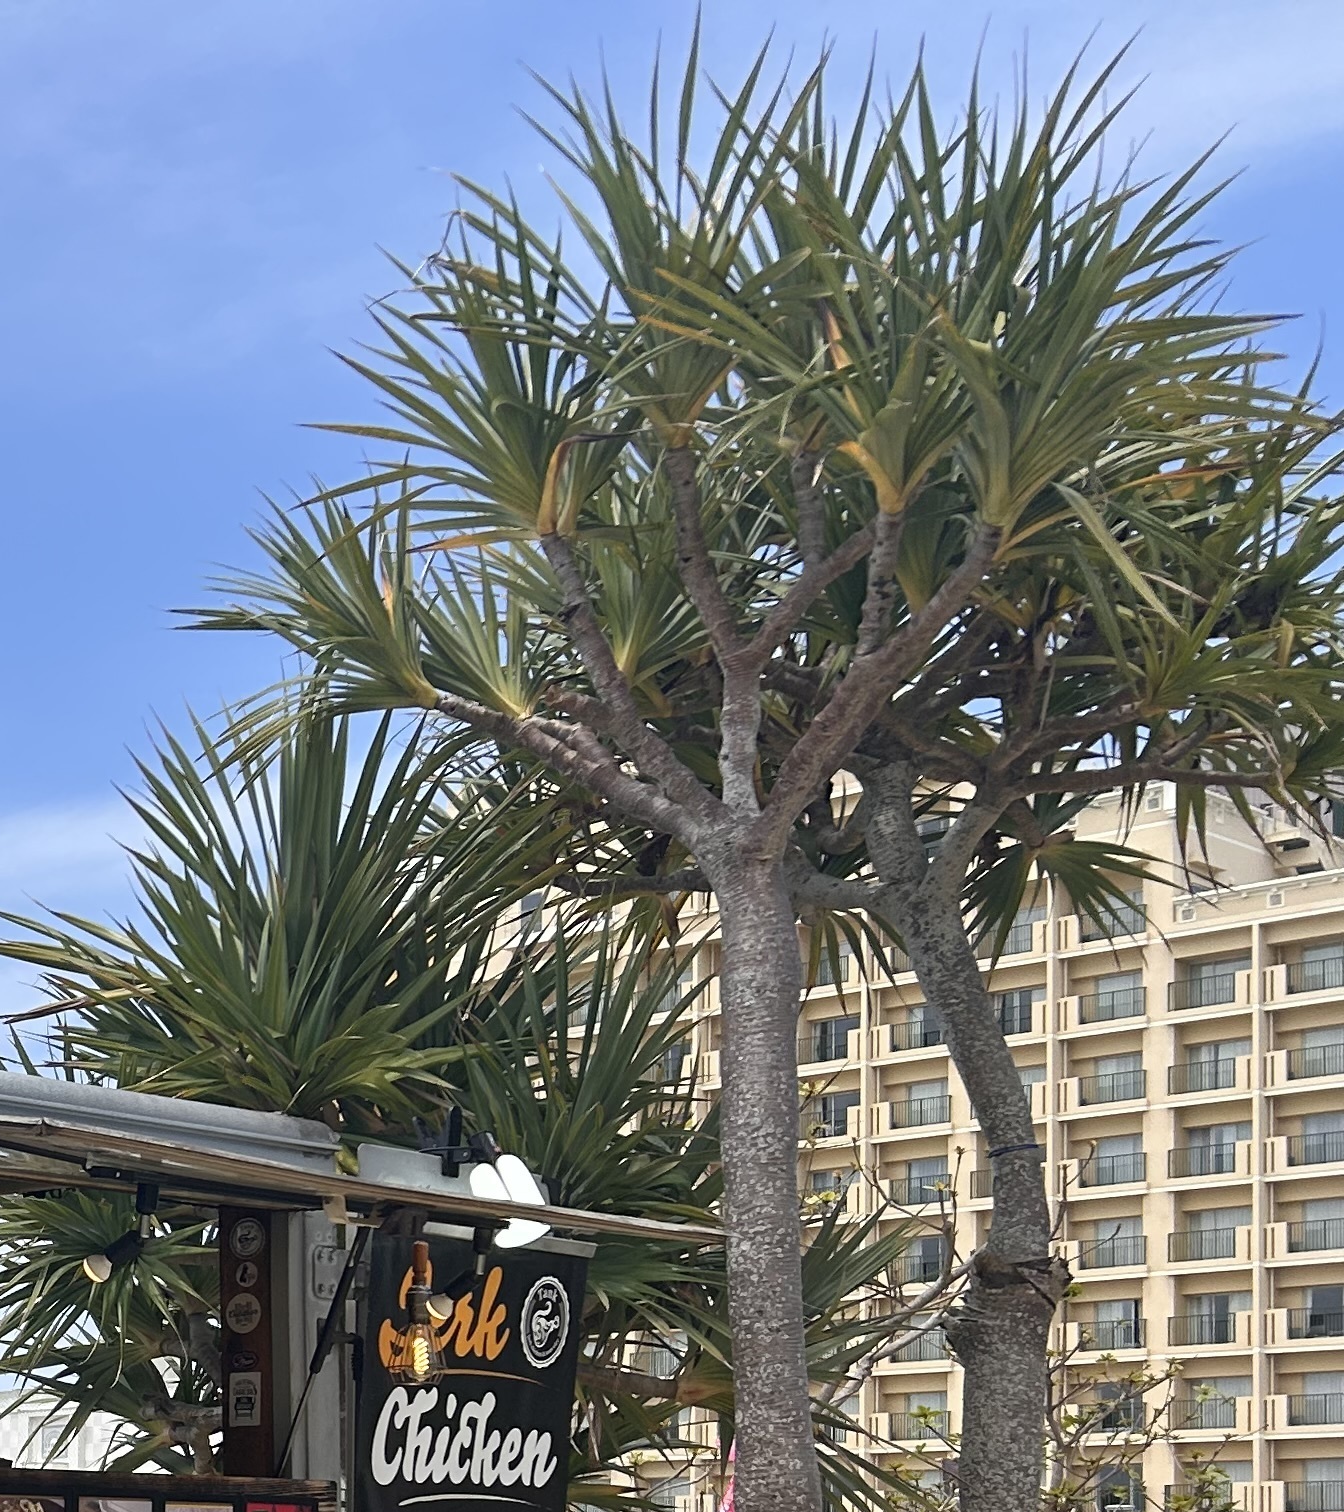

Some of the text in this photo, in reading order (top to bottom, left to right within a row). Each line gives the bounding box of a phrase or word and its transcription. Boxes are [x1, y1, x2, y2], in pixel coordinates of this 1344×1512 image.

[378, 1260, 510, 1371] Jrk
[537, 1287, 559, 1302] Tank
[371, 1386, 558, 1488] Chicken
